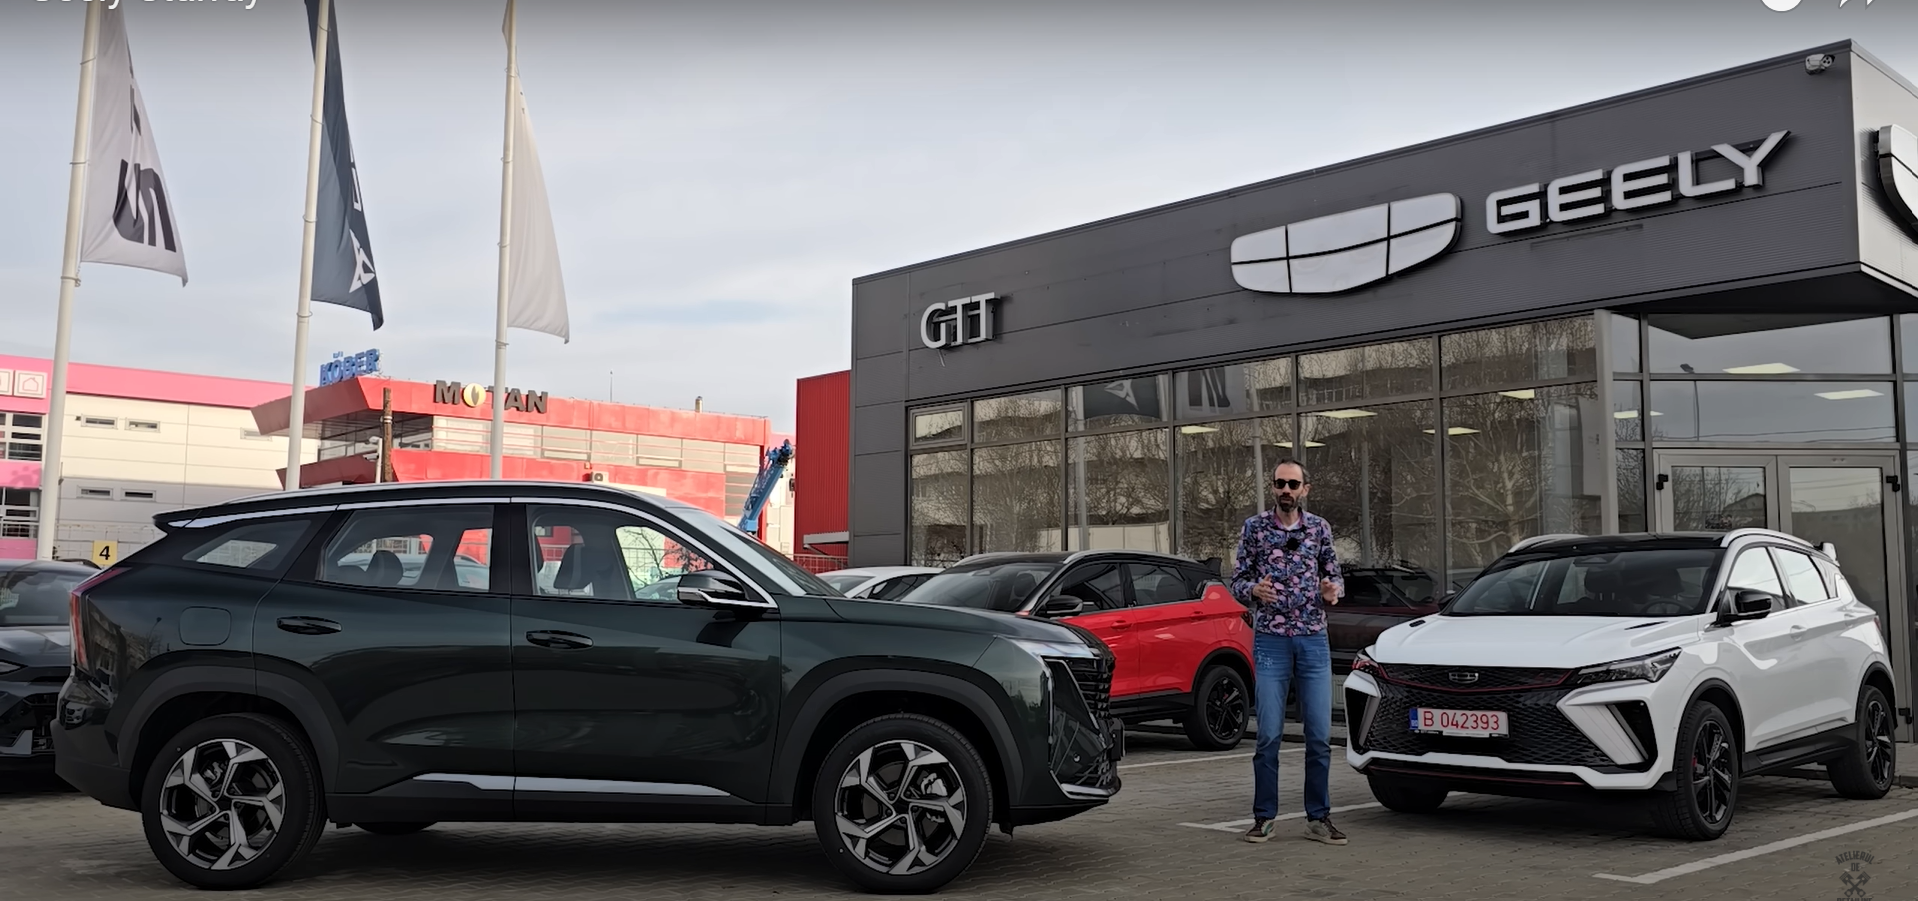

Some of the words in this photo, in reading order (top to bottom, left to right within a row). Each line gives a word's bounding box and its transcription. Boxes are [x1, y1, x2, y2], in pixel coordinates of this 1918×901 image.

[1486, 130, 1790, 235] GEELY
[921, 291, 998, 349] GTT
[99, 545, 111, 561] 4
[1423, 710, 1435, 728] B
[1440, 711, 1500, 731] 042393
